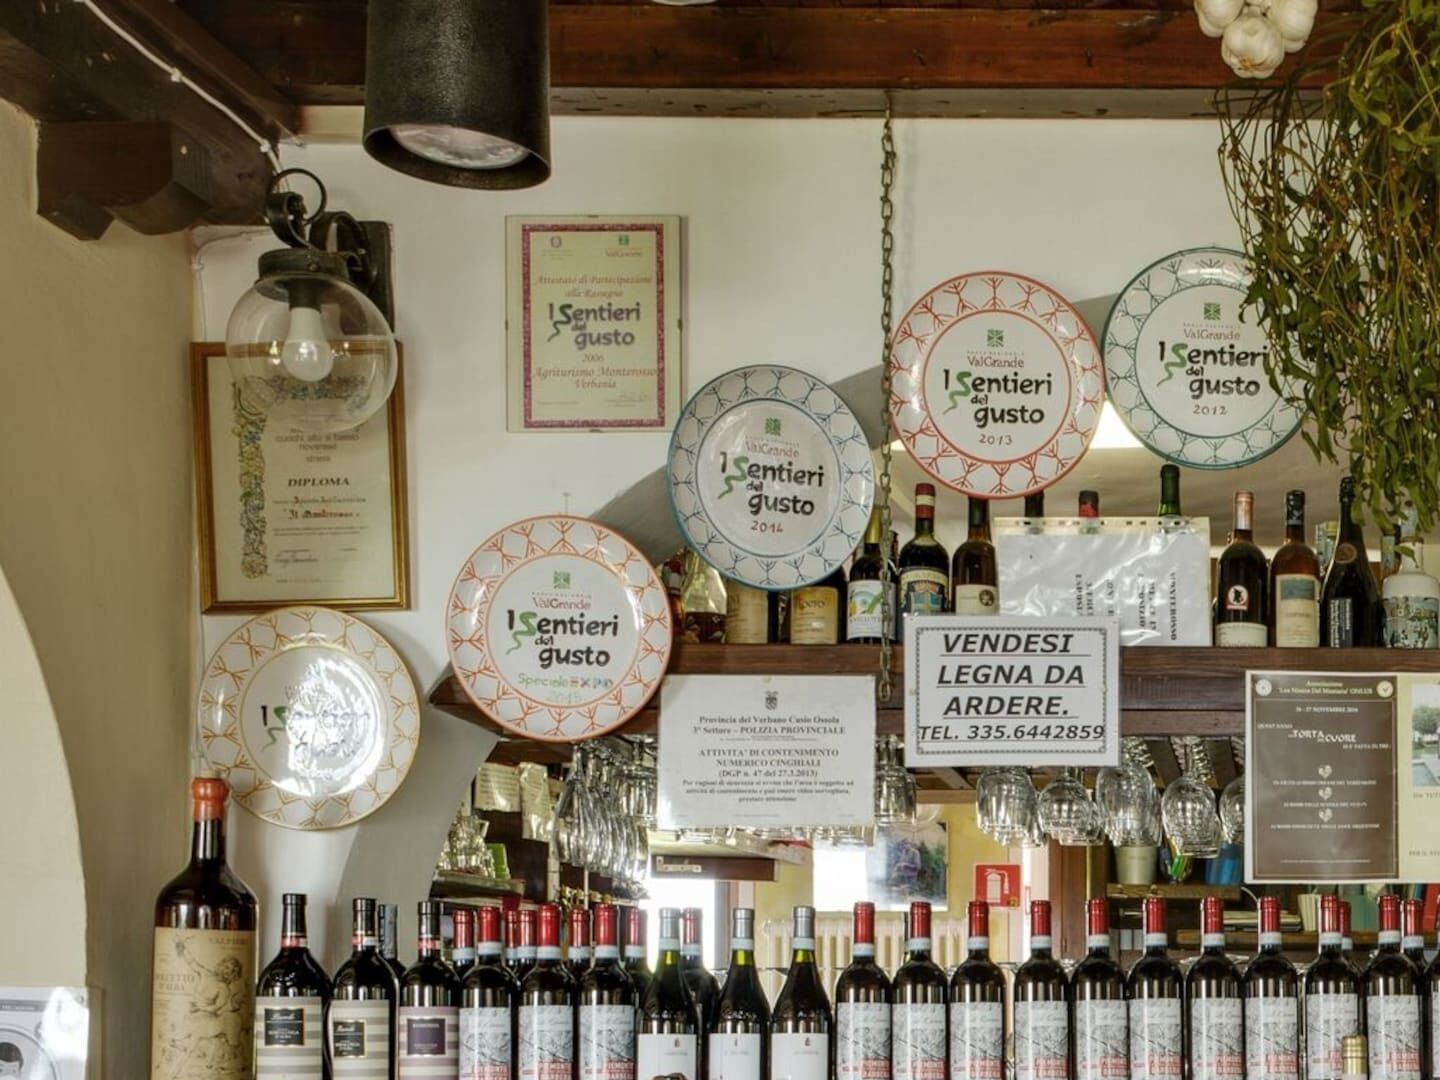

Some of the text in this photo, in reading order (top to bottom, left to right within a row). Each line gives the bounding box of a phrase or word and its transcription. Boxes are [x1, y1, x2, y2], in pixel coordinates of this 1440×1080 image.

[556, 301, 641, 326] Sentieri
[574, 328, 635, 350] gusto
[966, 355, 1025, 369] ValGrande
[1171, 342, 1268, 368] Sentieri
[1185, 366, 1205, 377] del
[956, 371, 1053, 397] Sentieri
[1188, 376, 1261, 400] gusto
[970, 394, 989, 406] del
[973, 405, 1045, 429] gusto
[1192, 404, 1229, 416] 2012
[978, 433, 1014, 446] 2013
[732, 456, 825, 488] Sentieri
[287, 477, 351, 488] DIPLOMA
[747, 493, 815, 516] gusto
[750, 520, 785, 534] 2014
[518, 611, 619, 637] Sentieri
[943, 634, 1074, 653] VENDESI
[538, 645, 611, 670] gusto
[937, 665, 1085, 684] LEGNA DA
[943, 696, 1069, 716] ARDERE.
[740, 726, 778, 735] POLIZIA
[780, 726, 846, 735] PROVINCIALE
[919, 724, 1105, 741] TEL. 335.6442859
[1293, 729, 1324, 739] TORTA
[1325, 734, 1356, 743] CUORE
[761, 749, 839, 758] CONTENIMENTO
[716, 758, 821, 768] NUMERICO CINGHIALI
